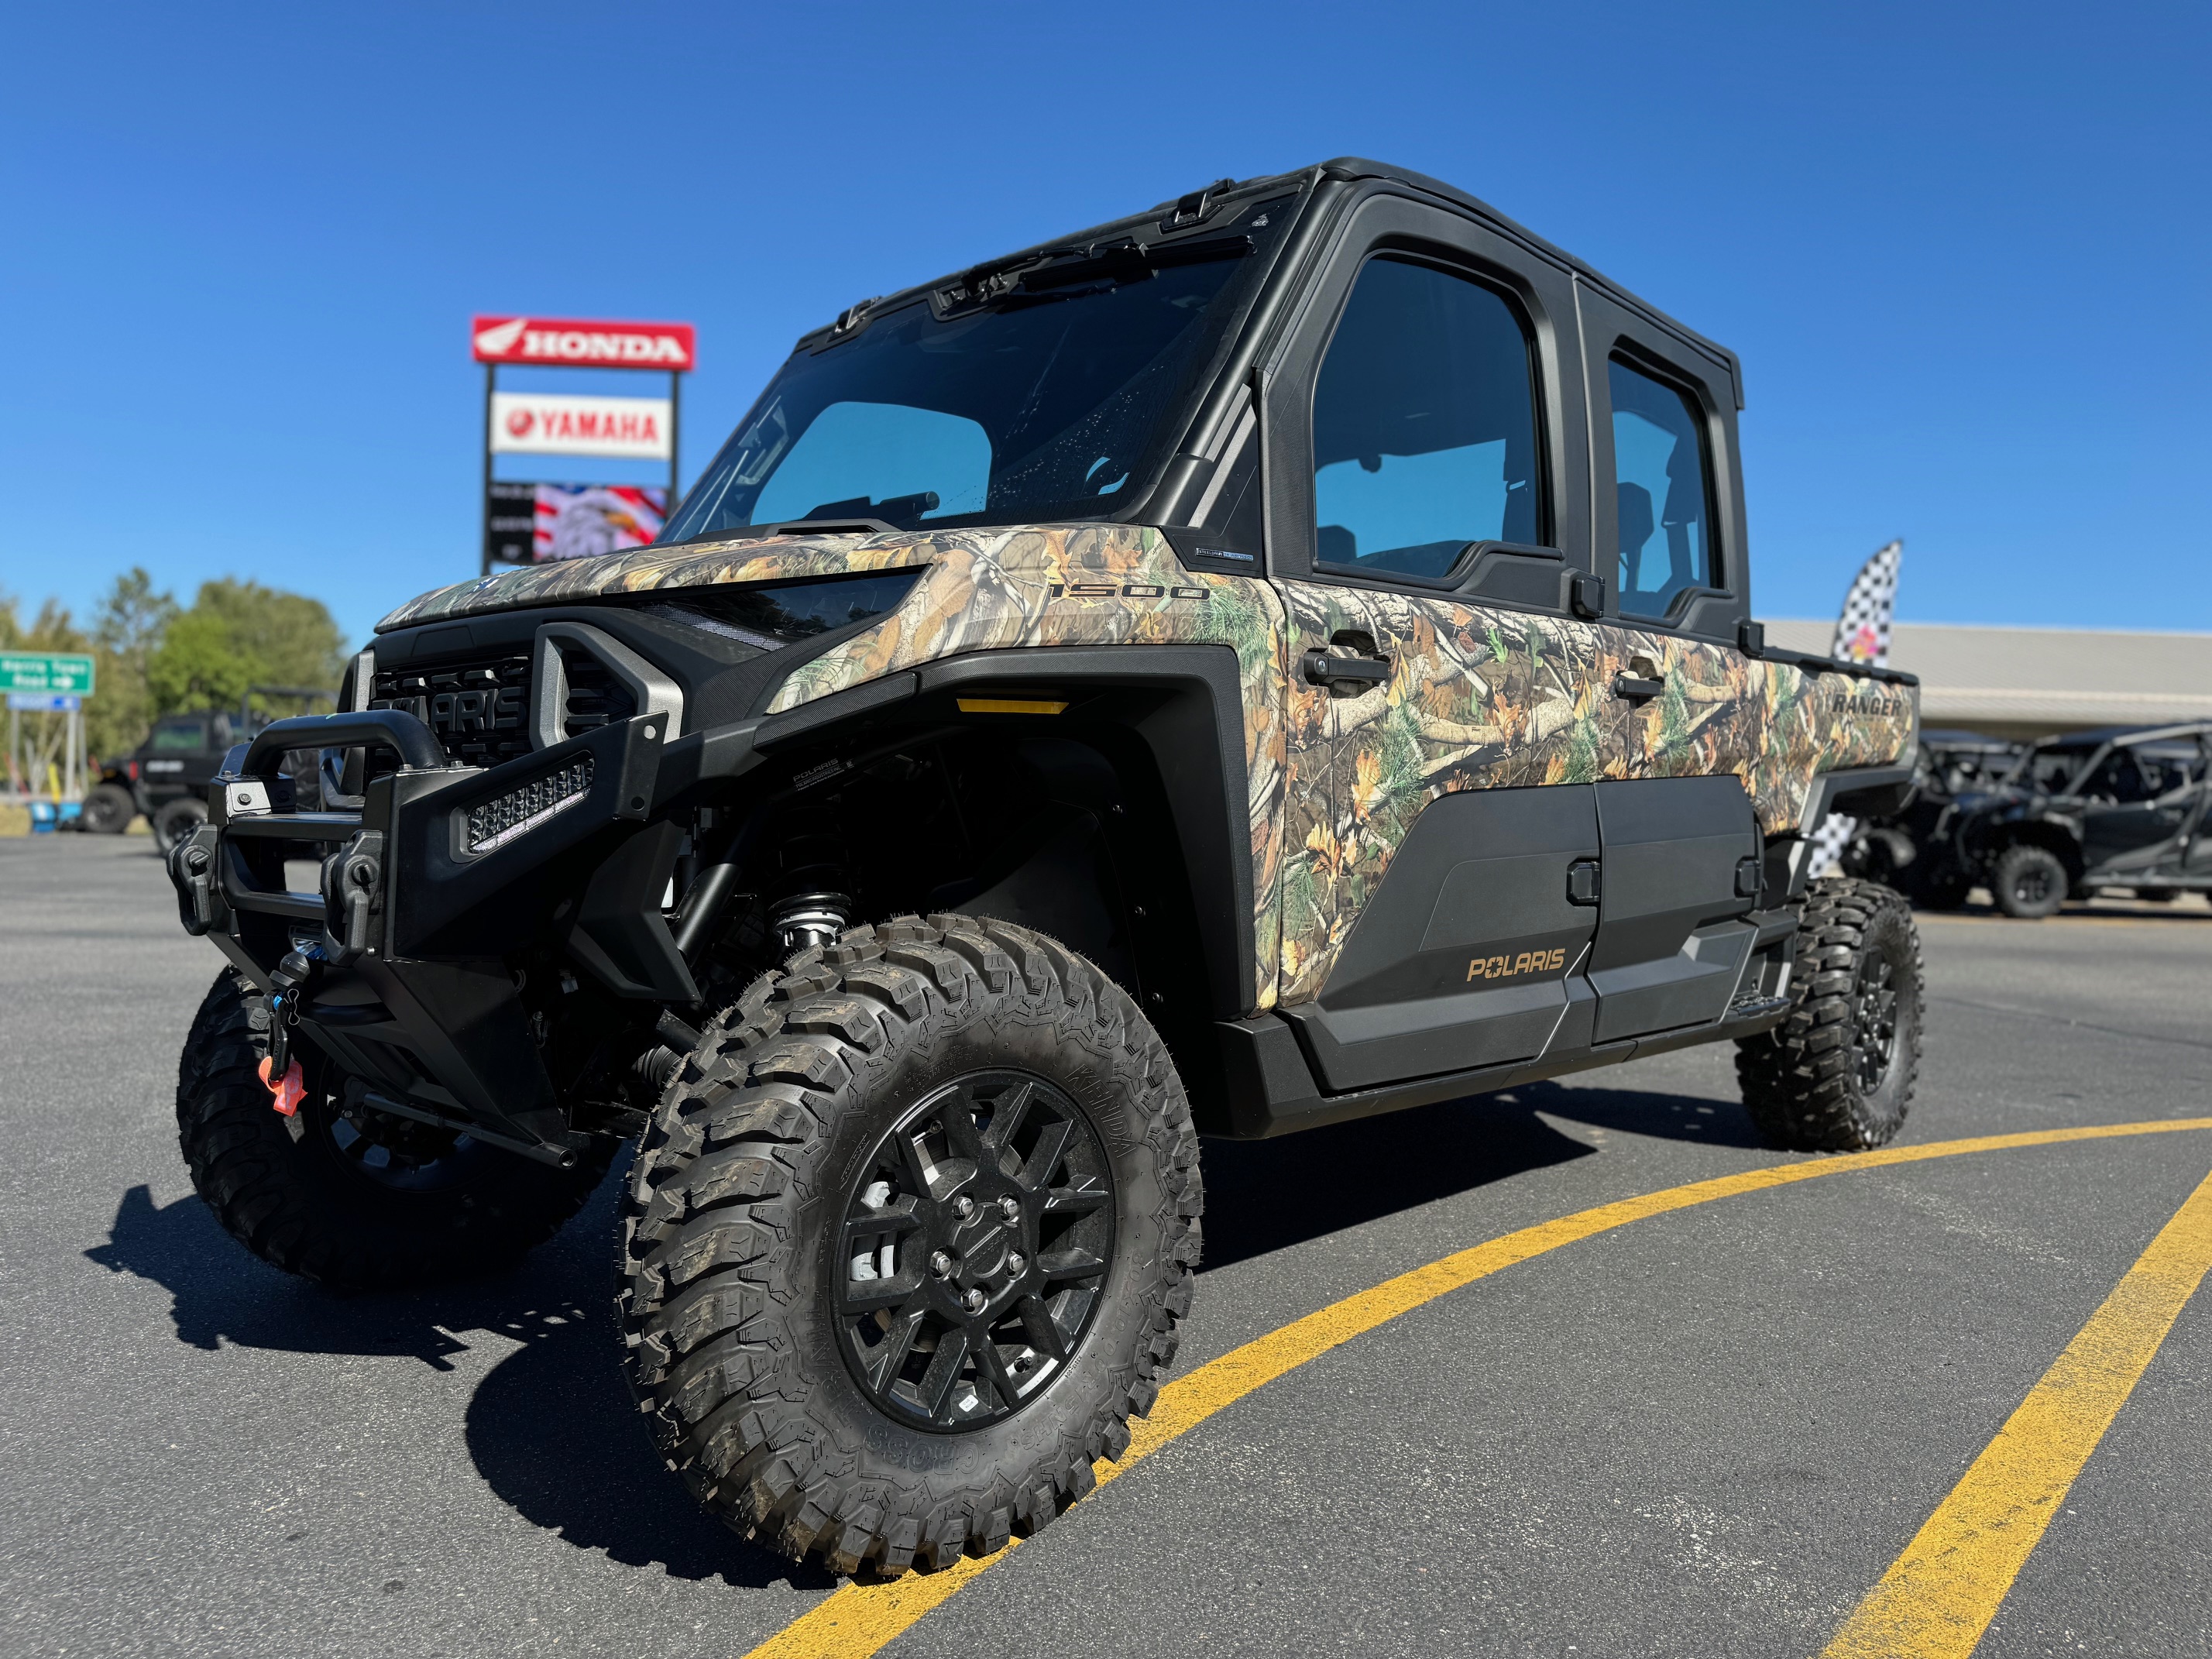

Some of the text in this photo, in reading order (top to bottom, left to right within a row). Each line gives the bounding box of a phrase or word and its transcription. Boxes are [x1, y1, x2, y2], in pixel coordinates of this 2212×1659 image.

[523, 330, 688, 362] HONDA
[541, 410, 659, 442] YAMAHA
[1048, 583, 1211, 601] 1500
[1832, 692, 1902, 717] RANGER
[793, 758, 839, 782] POLARIS
[1466, 948, 1566, 982] POLARIS
[1064, 1064, 1137, 1159] KENDA
[803, 1291, 980, 1475] CROSS TRAIL
